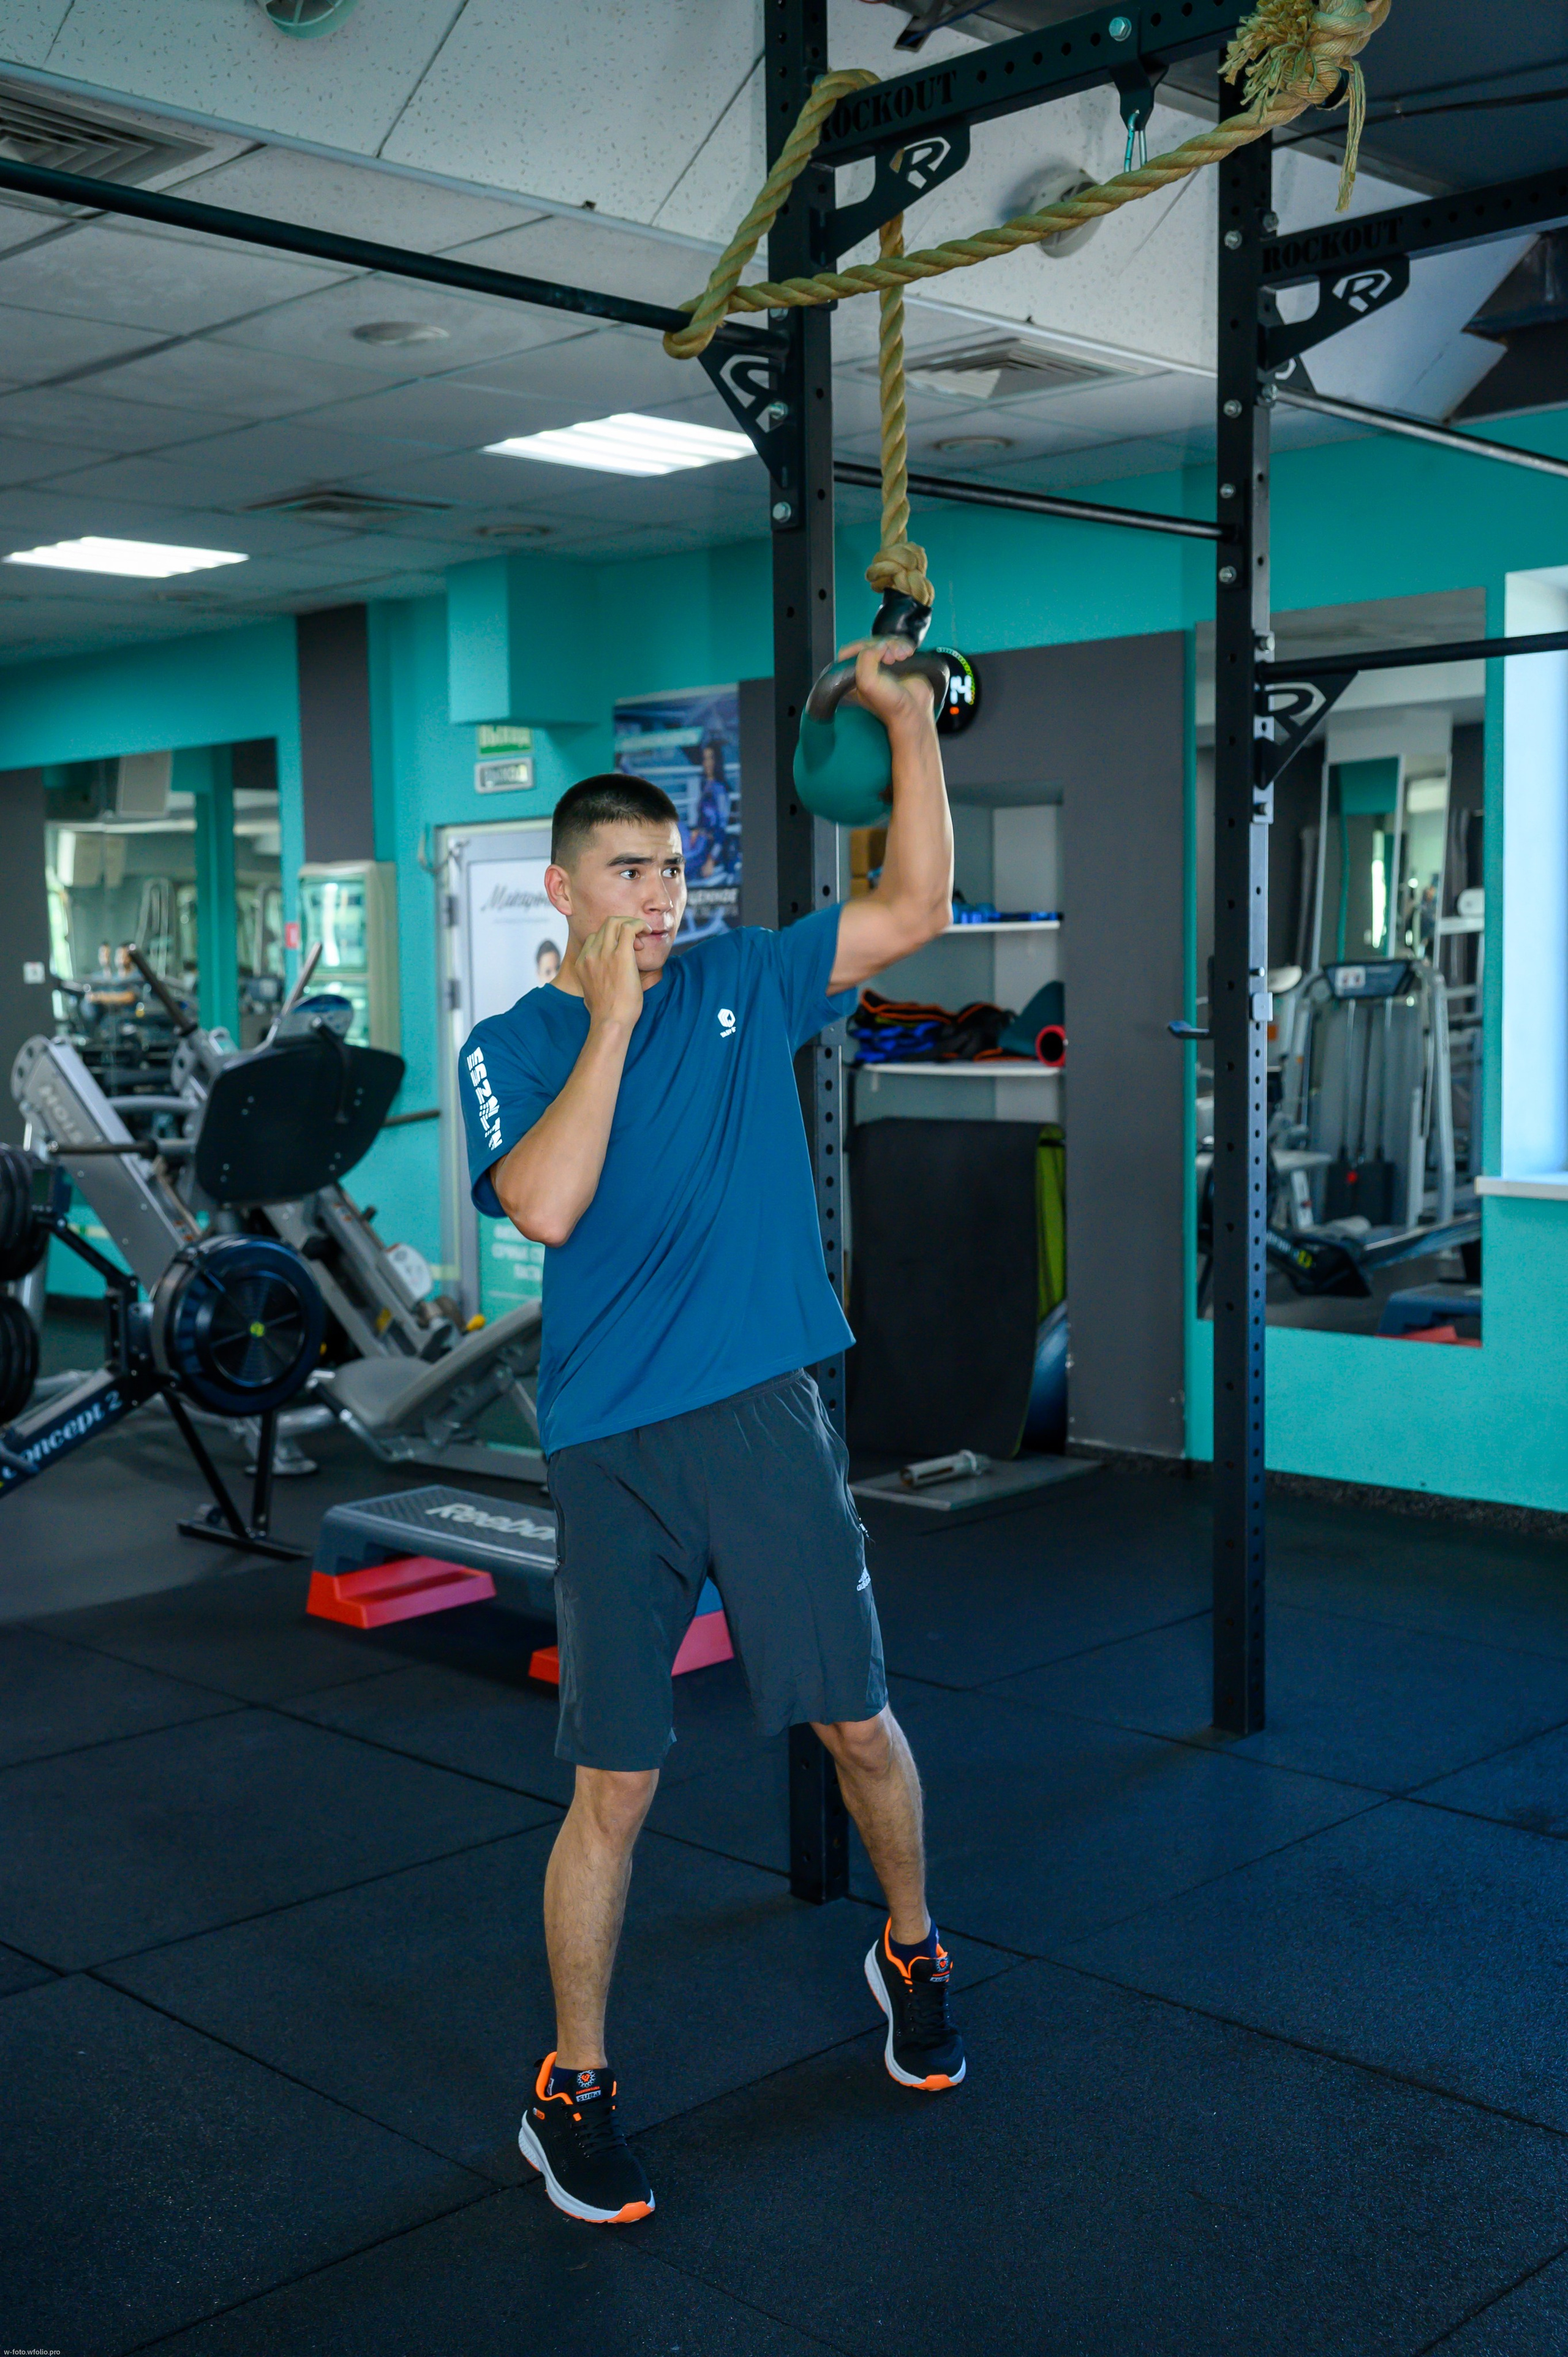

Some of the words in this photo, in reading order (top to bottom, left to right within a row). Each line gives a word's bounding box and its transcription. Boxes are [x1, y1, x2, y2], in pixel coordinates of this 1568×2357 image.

[1262, 217, 1403, 274] ROCKOUT
[104, 1390, 123, 1411] 2
[424, 1502, 556, 1544] Reebo
